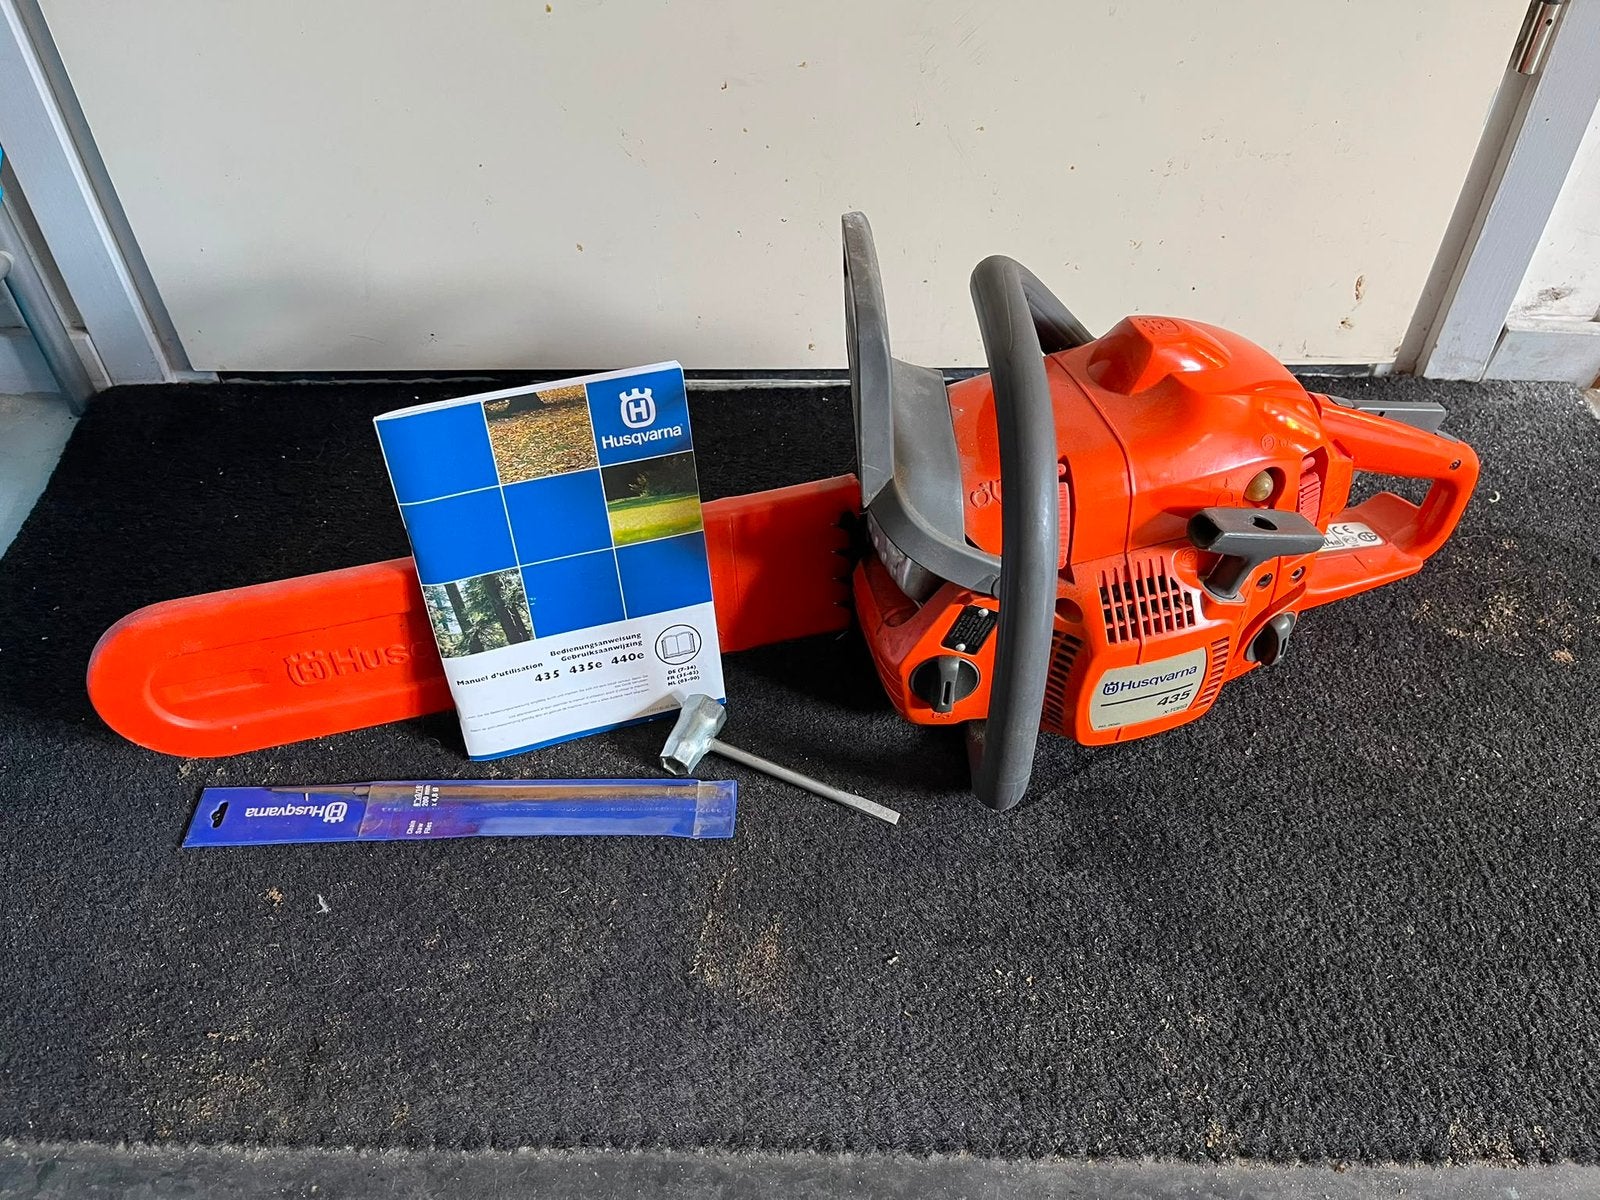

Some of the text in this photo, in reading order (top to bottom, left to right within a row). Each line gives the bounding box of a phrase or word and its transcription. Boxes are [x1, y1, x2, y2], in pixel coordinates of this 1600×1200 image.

[602, 425, 682, 449] Husqvarna
[550, 632, 642, 657] Bedienungsanweisung
[561, 640, 643, 662] Gebruiksaanwijzing
[456, 662, 544, 686] Manuel d'utilisation
[535, 651, 645, 683] 435 435e 440e
[1120, 665, 1198, 691] Husqvarna
[1156, 689, 1192, 706] 435
[245, 804, 326, 817] Husqvarna
[406, 820, 416, 835] Chain
[415, 822, 424, 835] Saw
